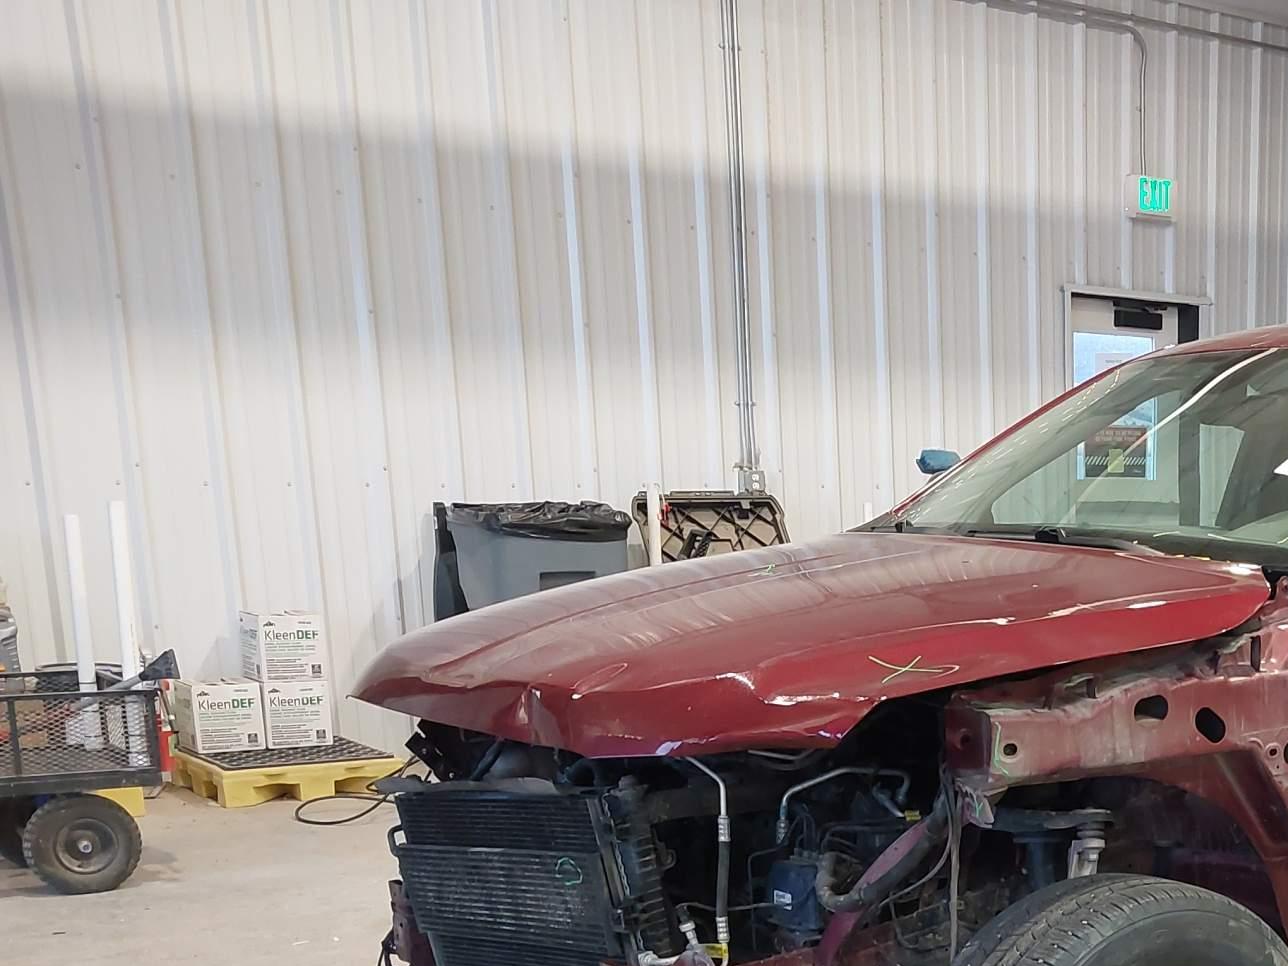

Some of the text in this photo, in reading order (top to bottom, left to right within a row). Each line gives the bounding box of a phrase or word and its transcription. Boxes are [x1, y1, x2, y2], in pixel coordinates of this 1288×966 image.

[1139, 177, 1171, 211] EXIT
[264, 629, 319, 641] KleenDEF
[198, 697, 255, 711] KleenDEF
[269, 695, 324, 708] KleenDEF
